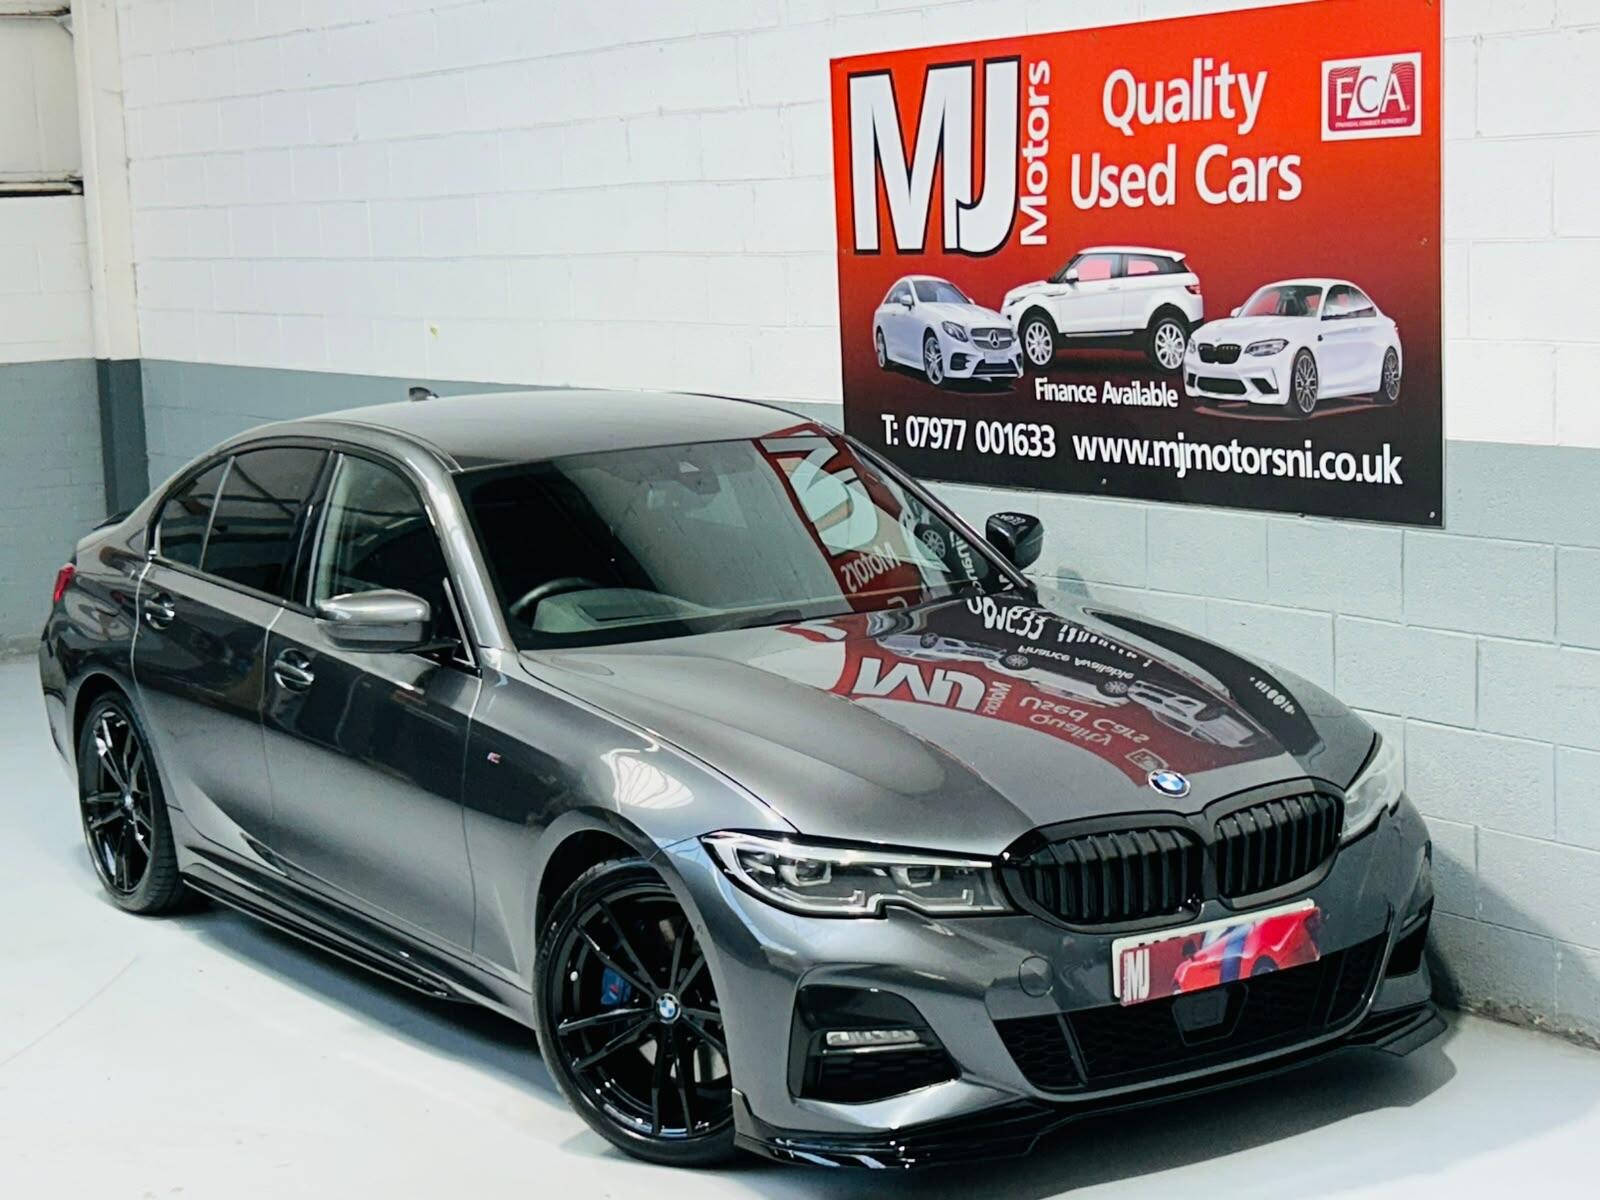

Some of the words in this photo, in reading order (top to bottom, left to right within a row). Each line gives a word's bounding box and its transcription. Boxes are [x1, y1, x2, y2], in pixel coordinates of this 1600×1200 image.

[1102, 57, 1268, 136] Quality
[1335, 73, 1408, 117] FCA
[847, 55, 1021, 255] MJ
[1019, 60, 1051, 246] Motors
[1071, 144, 1177, 210] Used
[1195, 144, 1302, 205] Cars
[1034, 376, 1097, 404] Finance
[1101, 380, 1179, 408] Available
[881, 413, 899, 446] T:
[905, 415, 967, 451] 07977
[975, 420, 1056, 458] 001633
[1072, 431, 1403, 485] www.mjmotorsni.co.uk
